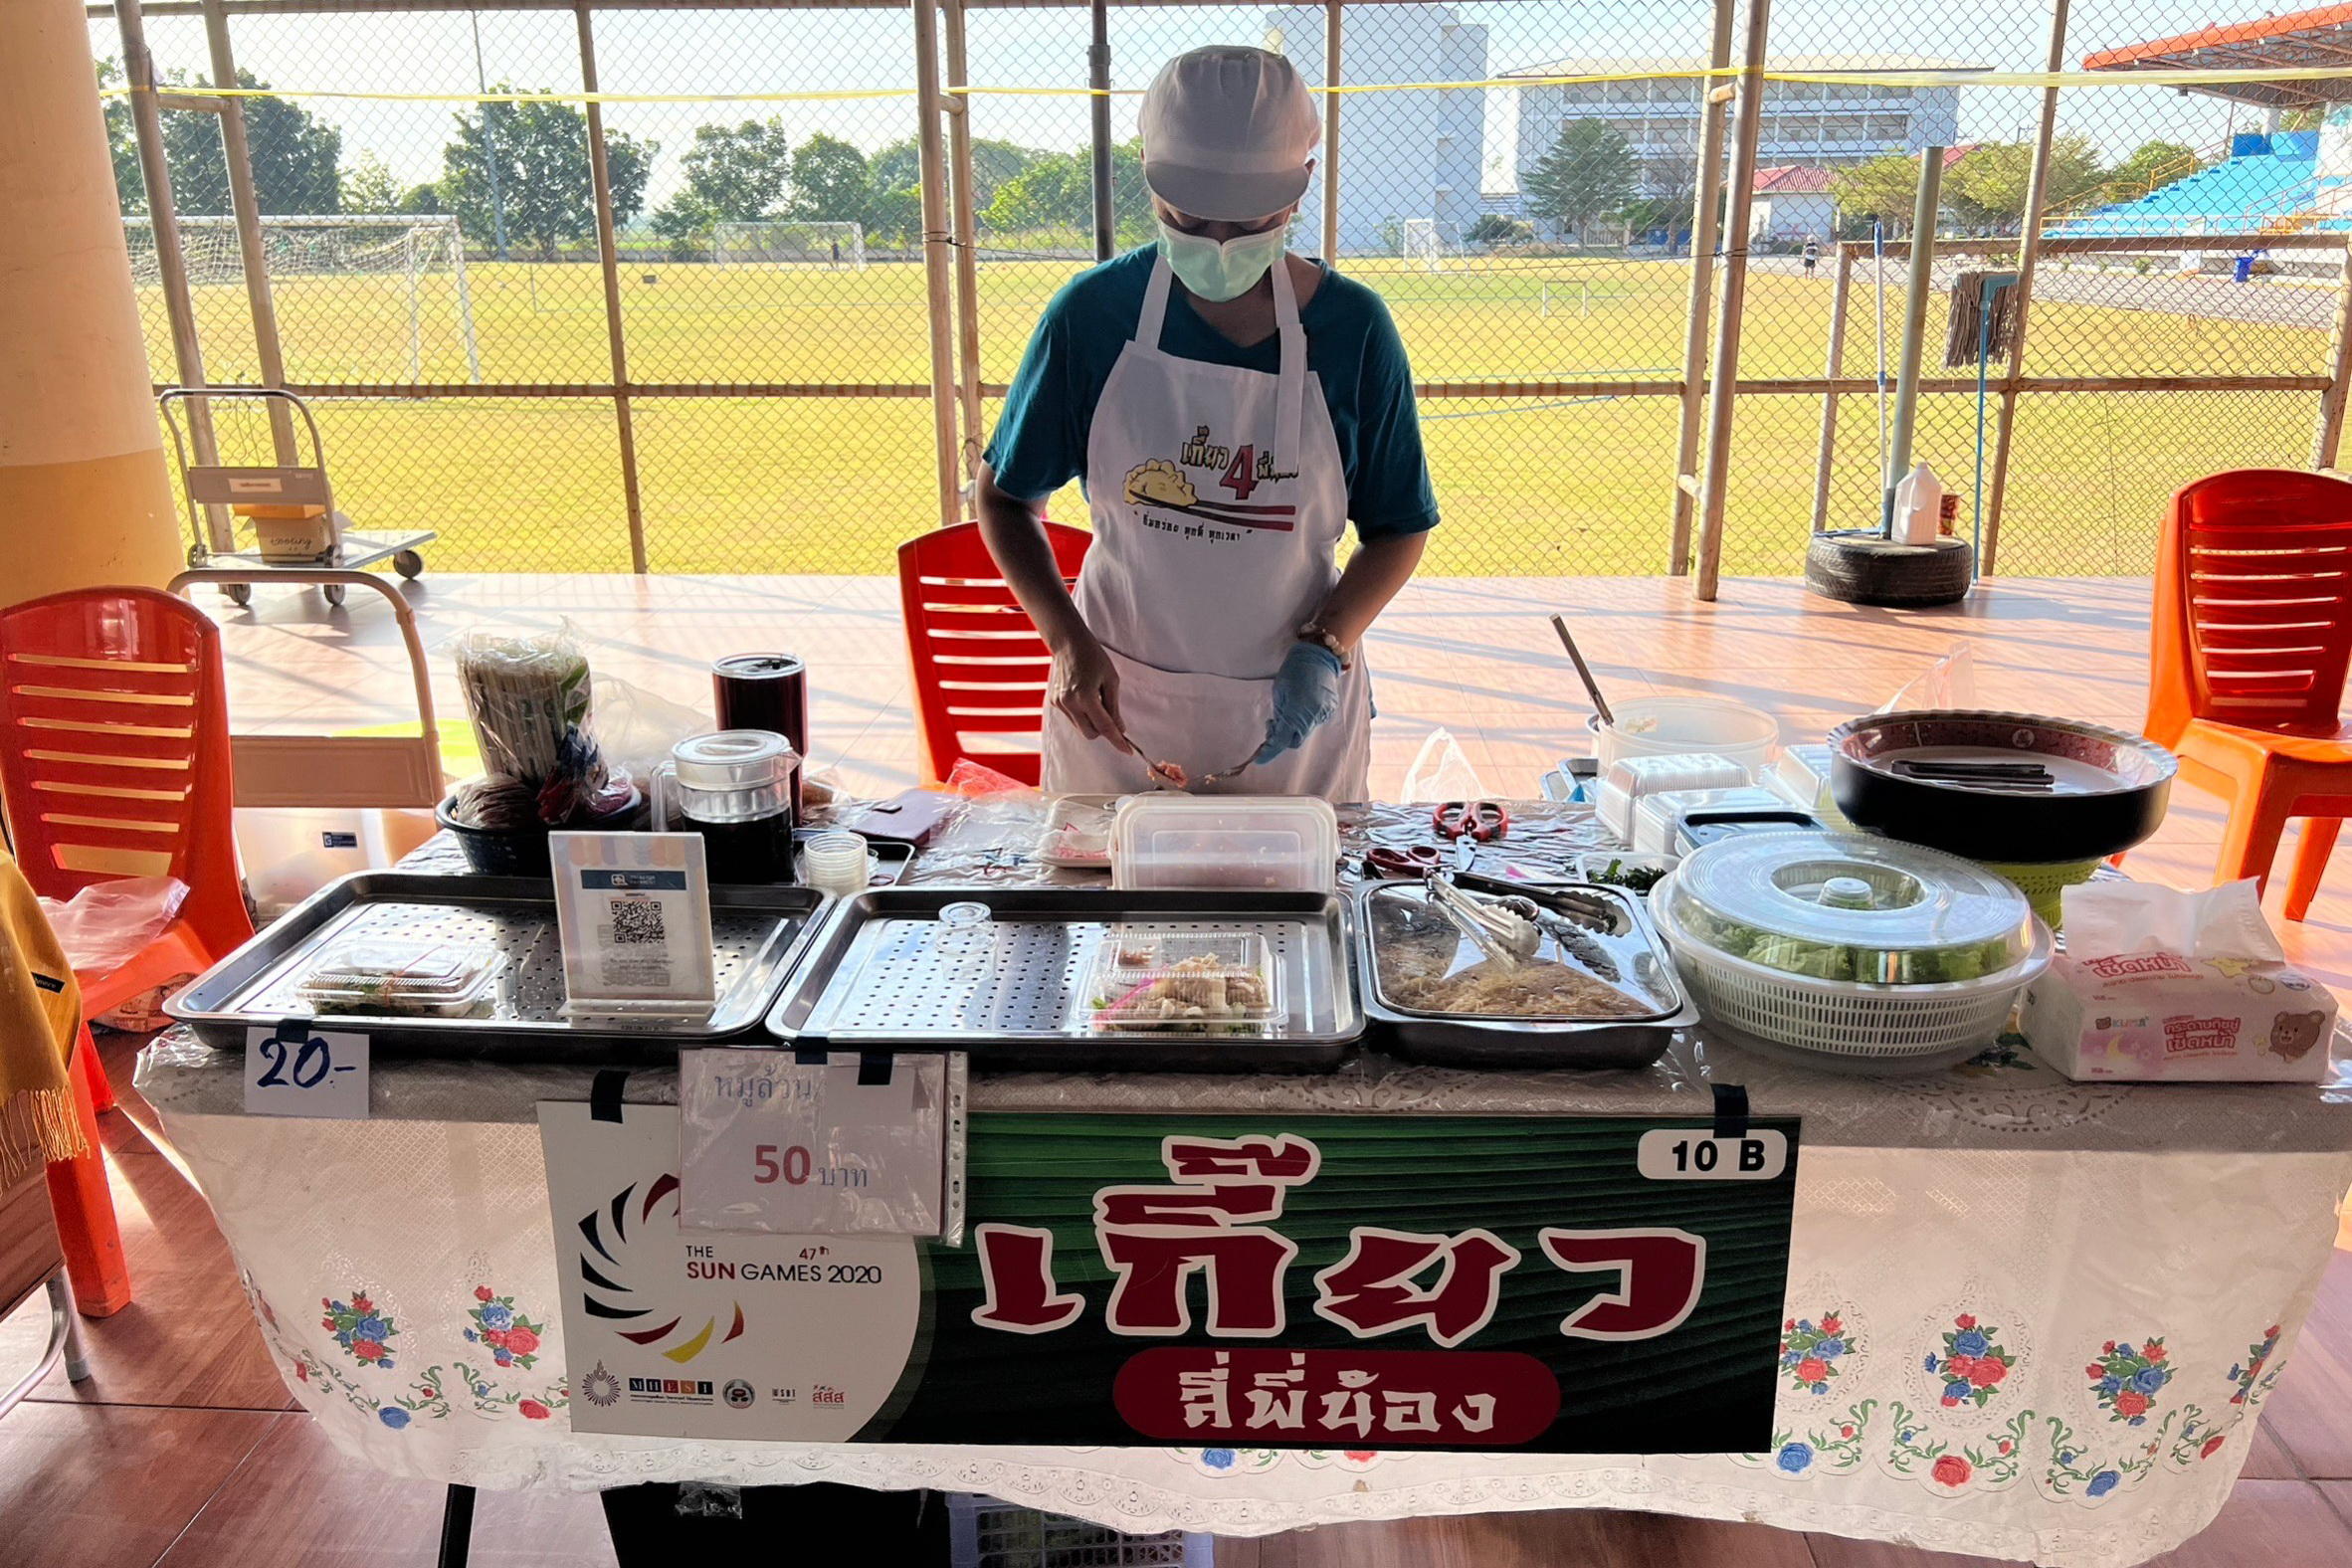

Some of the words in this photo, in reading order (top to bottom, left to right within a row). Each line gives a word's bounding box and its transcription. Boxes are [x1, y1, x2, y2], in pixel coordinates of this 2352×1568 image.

[1219, 443, 1260, 500] 4
[714, 1064, 812, 1107] หมูล้วน
[754, 1144, 812, 1186] 50
[818, 1166, 869, 1189] บาท
[1672, 1139, 1718, 1172] 10
[1738, 1139, 1766, 1172] B
[686, 1245, 713, 1259] THE
[686, 1262, 735, 1280] SUN
[740, 1264, 822, 1282] GAMES
[827, 1266, 882, 1284] 2020
[631, 1379, 710, 1394] MHESI
[1178, 1351, 1498, 1438] สี่พี่น้อง
